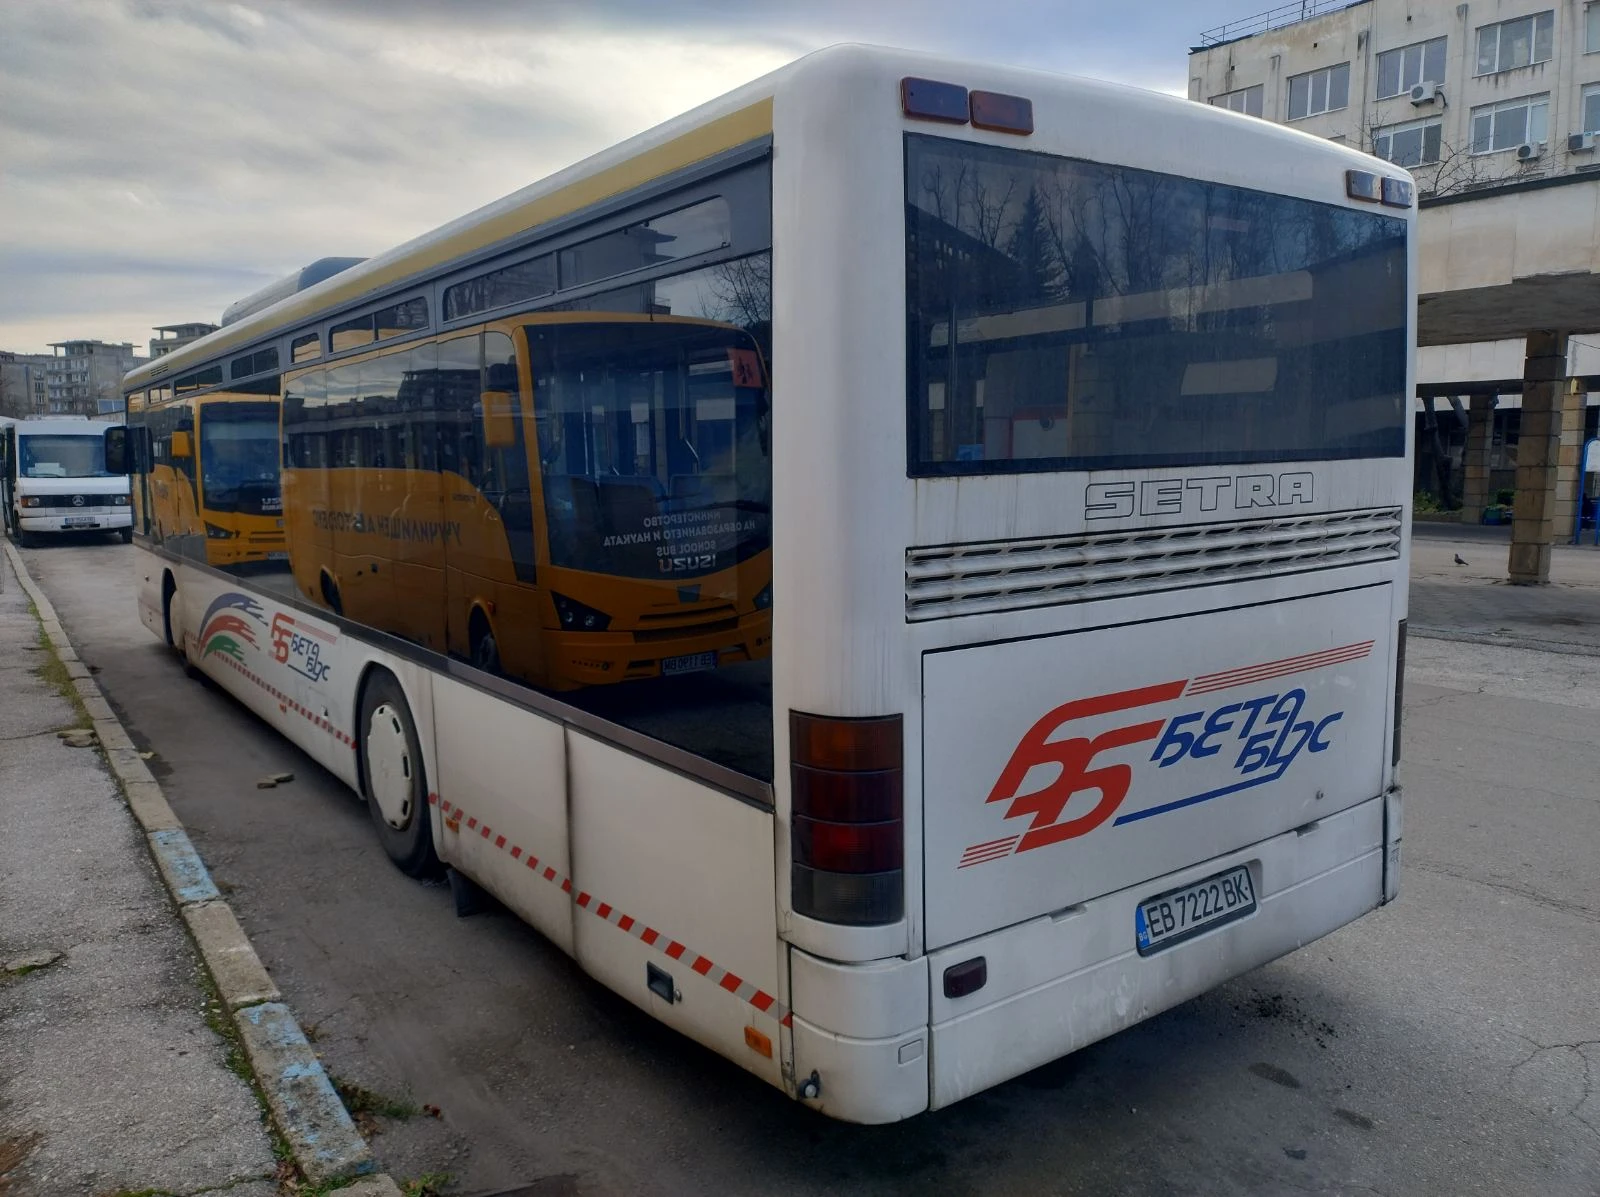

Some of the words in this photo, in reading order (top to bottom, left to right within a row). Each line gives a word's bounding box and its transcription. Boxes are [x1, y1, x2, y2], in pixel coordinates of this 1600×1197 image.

[1084, 471, 1314, 520] SETRA
[1149, 688, 1306, 768] БЕТА
[1146, 902, 1176, 938] EB
[1175, 884, 1224, 927] 7222
[1221, 873, 1249, 908] BK
